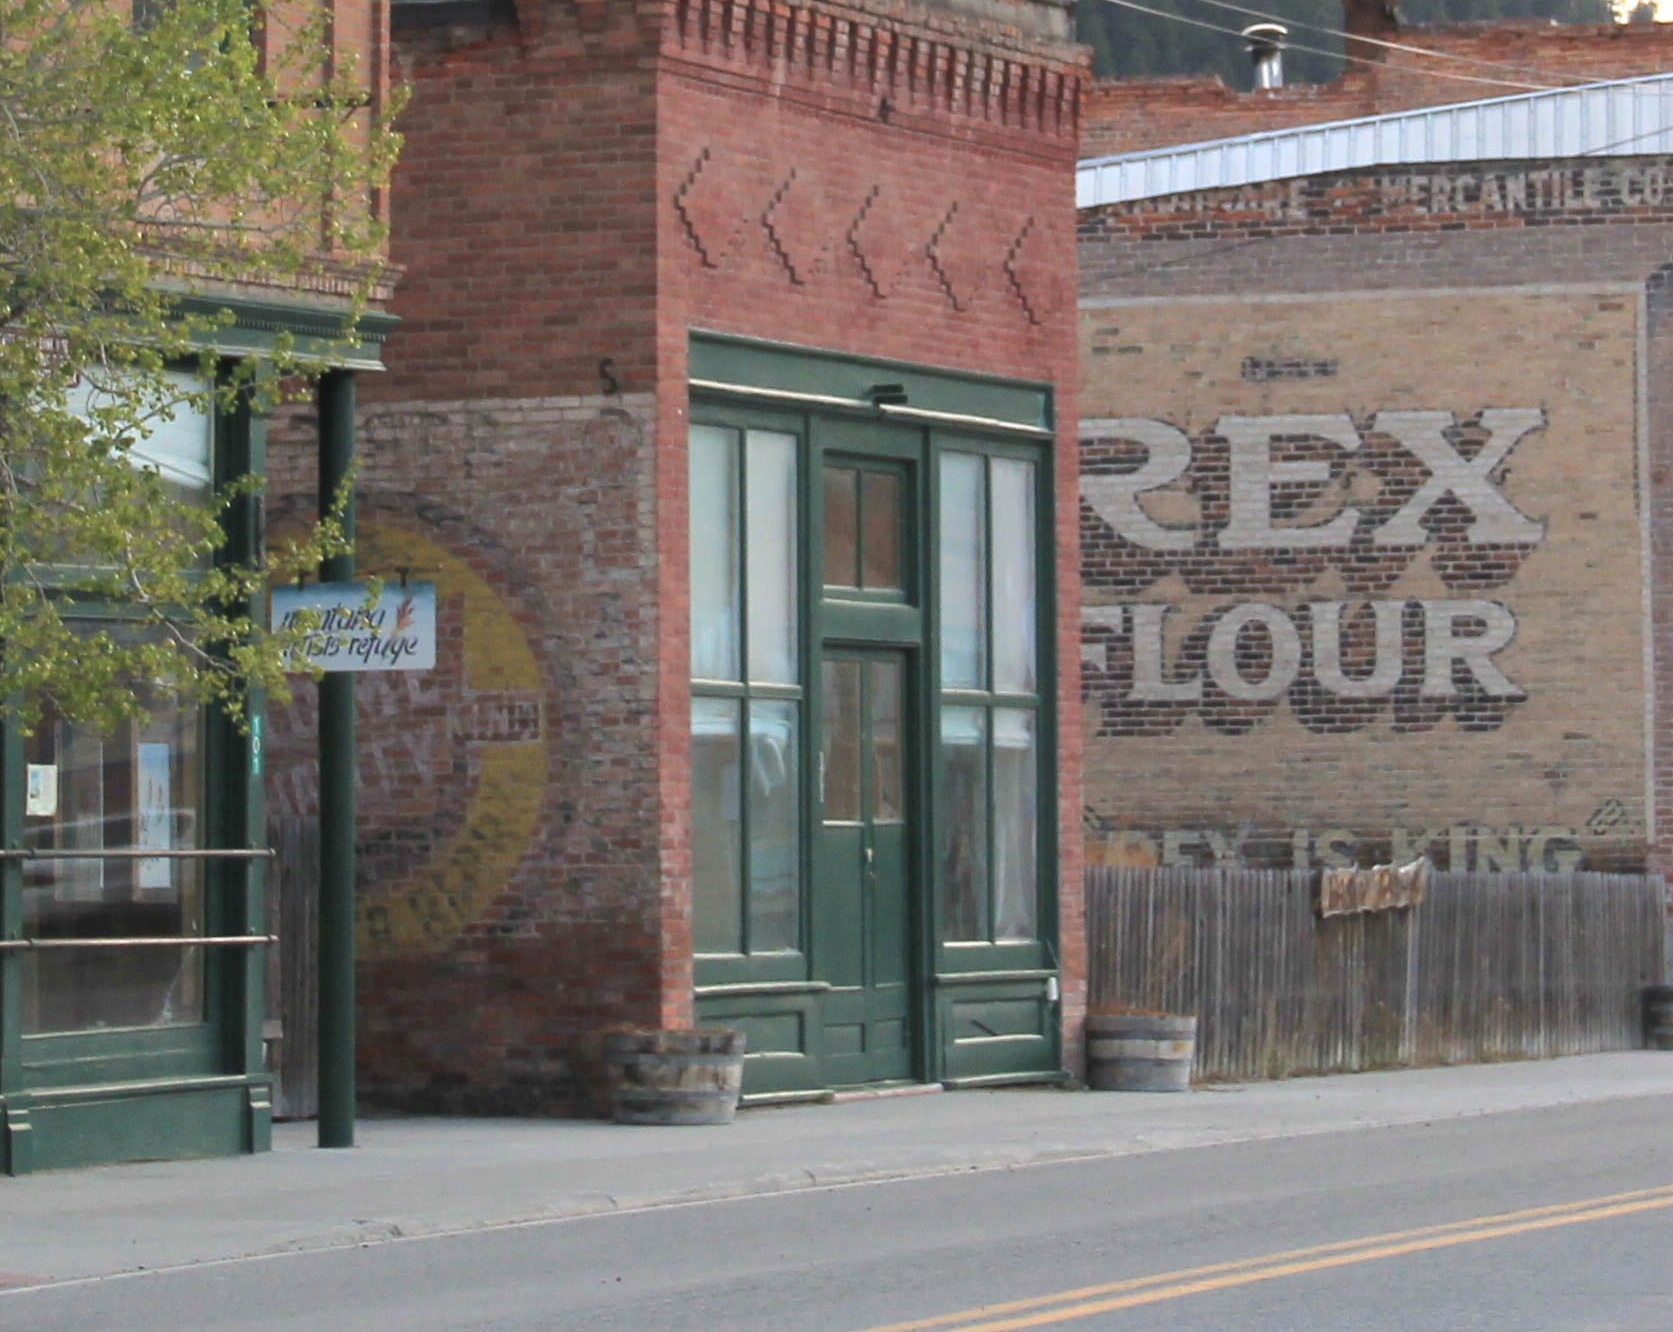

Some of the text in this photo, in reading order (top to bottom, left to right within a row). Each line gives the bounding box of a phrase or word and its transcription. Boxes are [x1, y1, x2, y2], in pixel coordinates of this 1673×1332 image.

[1079, 408, 1545, 550] REX
[348, 635, 418, 664] refuge
[1392, 824, 1582, 872] KING
